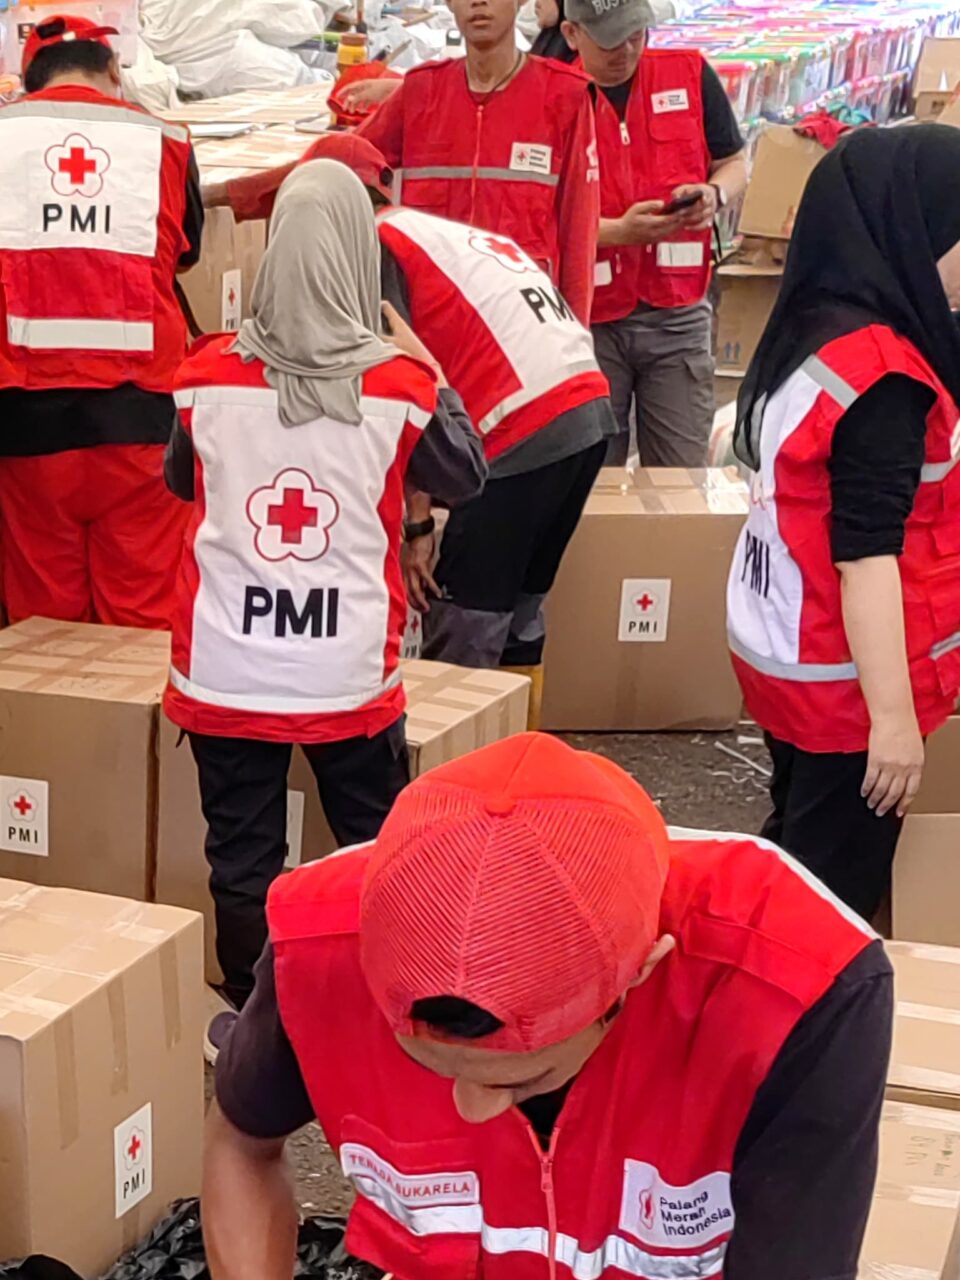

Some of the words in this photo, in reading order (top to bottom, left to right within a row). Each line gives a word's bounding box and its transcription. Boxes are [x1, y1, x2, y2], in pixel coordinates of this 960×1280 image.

[43, 203, 111, 234] PMI
[519, 286, 575, 324] PM
[242, 585, 339, 638] PMI
[628, 620, 658, 633] PMI
[8, 826, 38, 844] PMI
[123, 1167, 145, 1200] PMI
[660, 1191, 709, 1211] Palang
[663, 1207, 732, 1236] Indonesia
